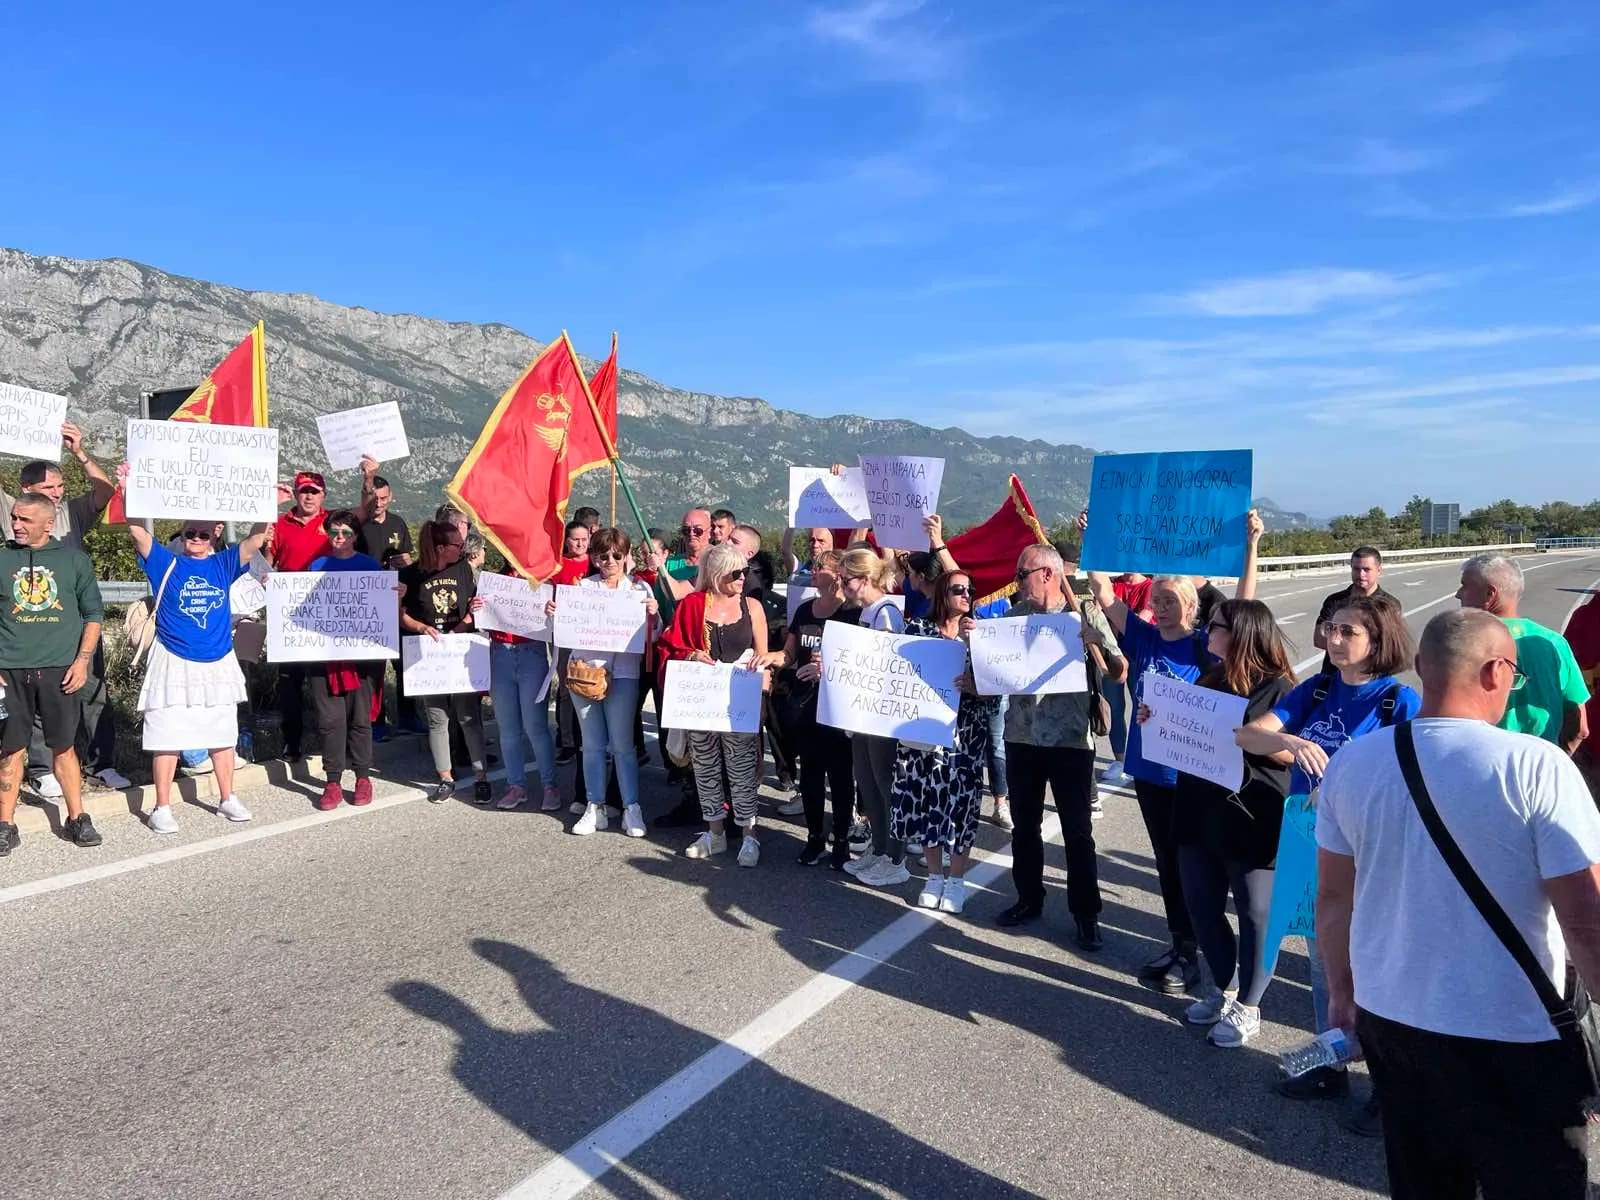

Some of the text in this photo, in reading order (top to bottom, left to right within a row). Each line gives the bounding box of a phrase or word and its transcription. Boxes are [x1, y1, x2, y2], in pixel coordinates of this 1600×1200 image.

[38, 415, 48, 427] U
[131, 423, 278, 450] POPISNO ZAKONODAVSTVO
[190, 446, 208, 463] EU
[137, 457, 154, 474] NE
[1158, 469, 1238, 489] CRNOGORAC
[198, 479, 272, 499] PRIPADNOSTI
[162, 495, 258, 514] VJERE I JEZIKA
[904, 493, 928, 511] SRBA
[1151, 494, 1177, 512] POD
[1114, 513, 1224, 537] SRBIJANSKOM
[272, 577, 289, 590] NA
[293, 576, 341, 591] POPISNOM
[289, 591, 368, 605] NEMA NIJEDNE
[282, 606, 323, 619] OZNAKE
[334, 606, 379, 620] SIMBOLA
[282, 619, 308, 633] KOJI
[980, 625, 997, 640] ZA
[333, 635, 359, 648] CRNU
[362, 635, 389, 648] GORU
[872, 634, 902, 656] SPC
[833, 646, 849, 665] JE
[826, 666, 952, 705] U PROCES SELEKCIJE
[1153, 681, 1217, 713] CRNOGORCI
[850, 694, 920, 721] ANKETARA
[1159, 727, 1216, 754] PLANIRANOM
